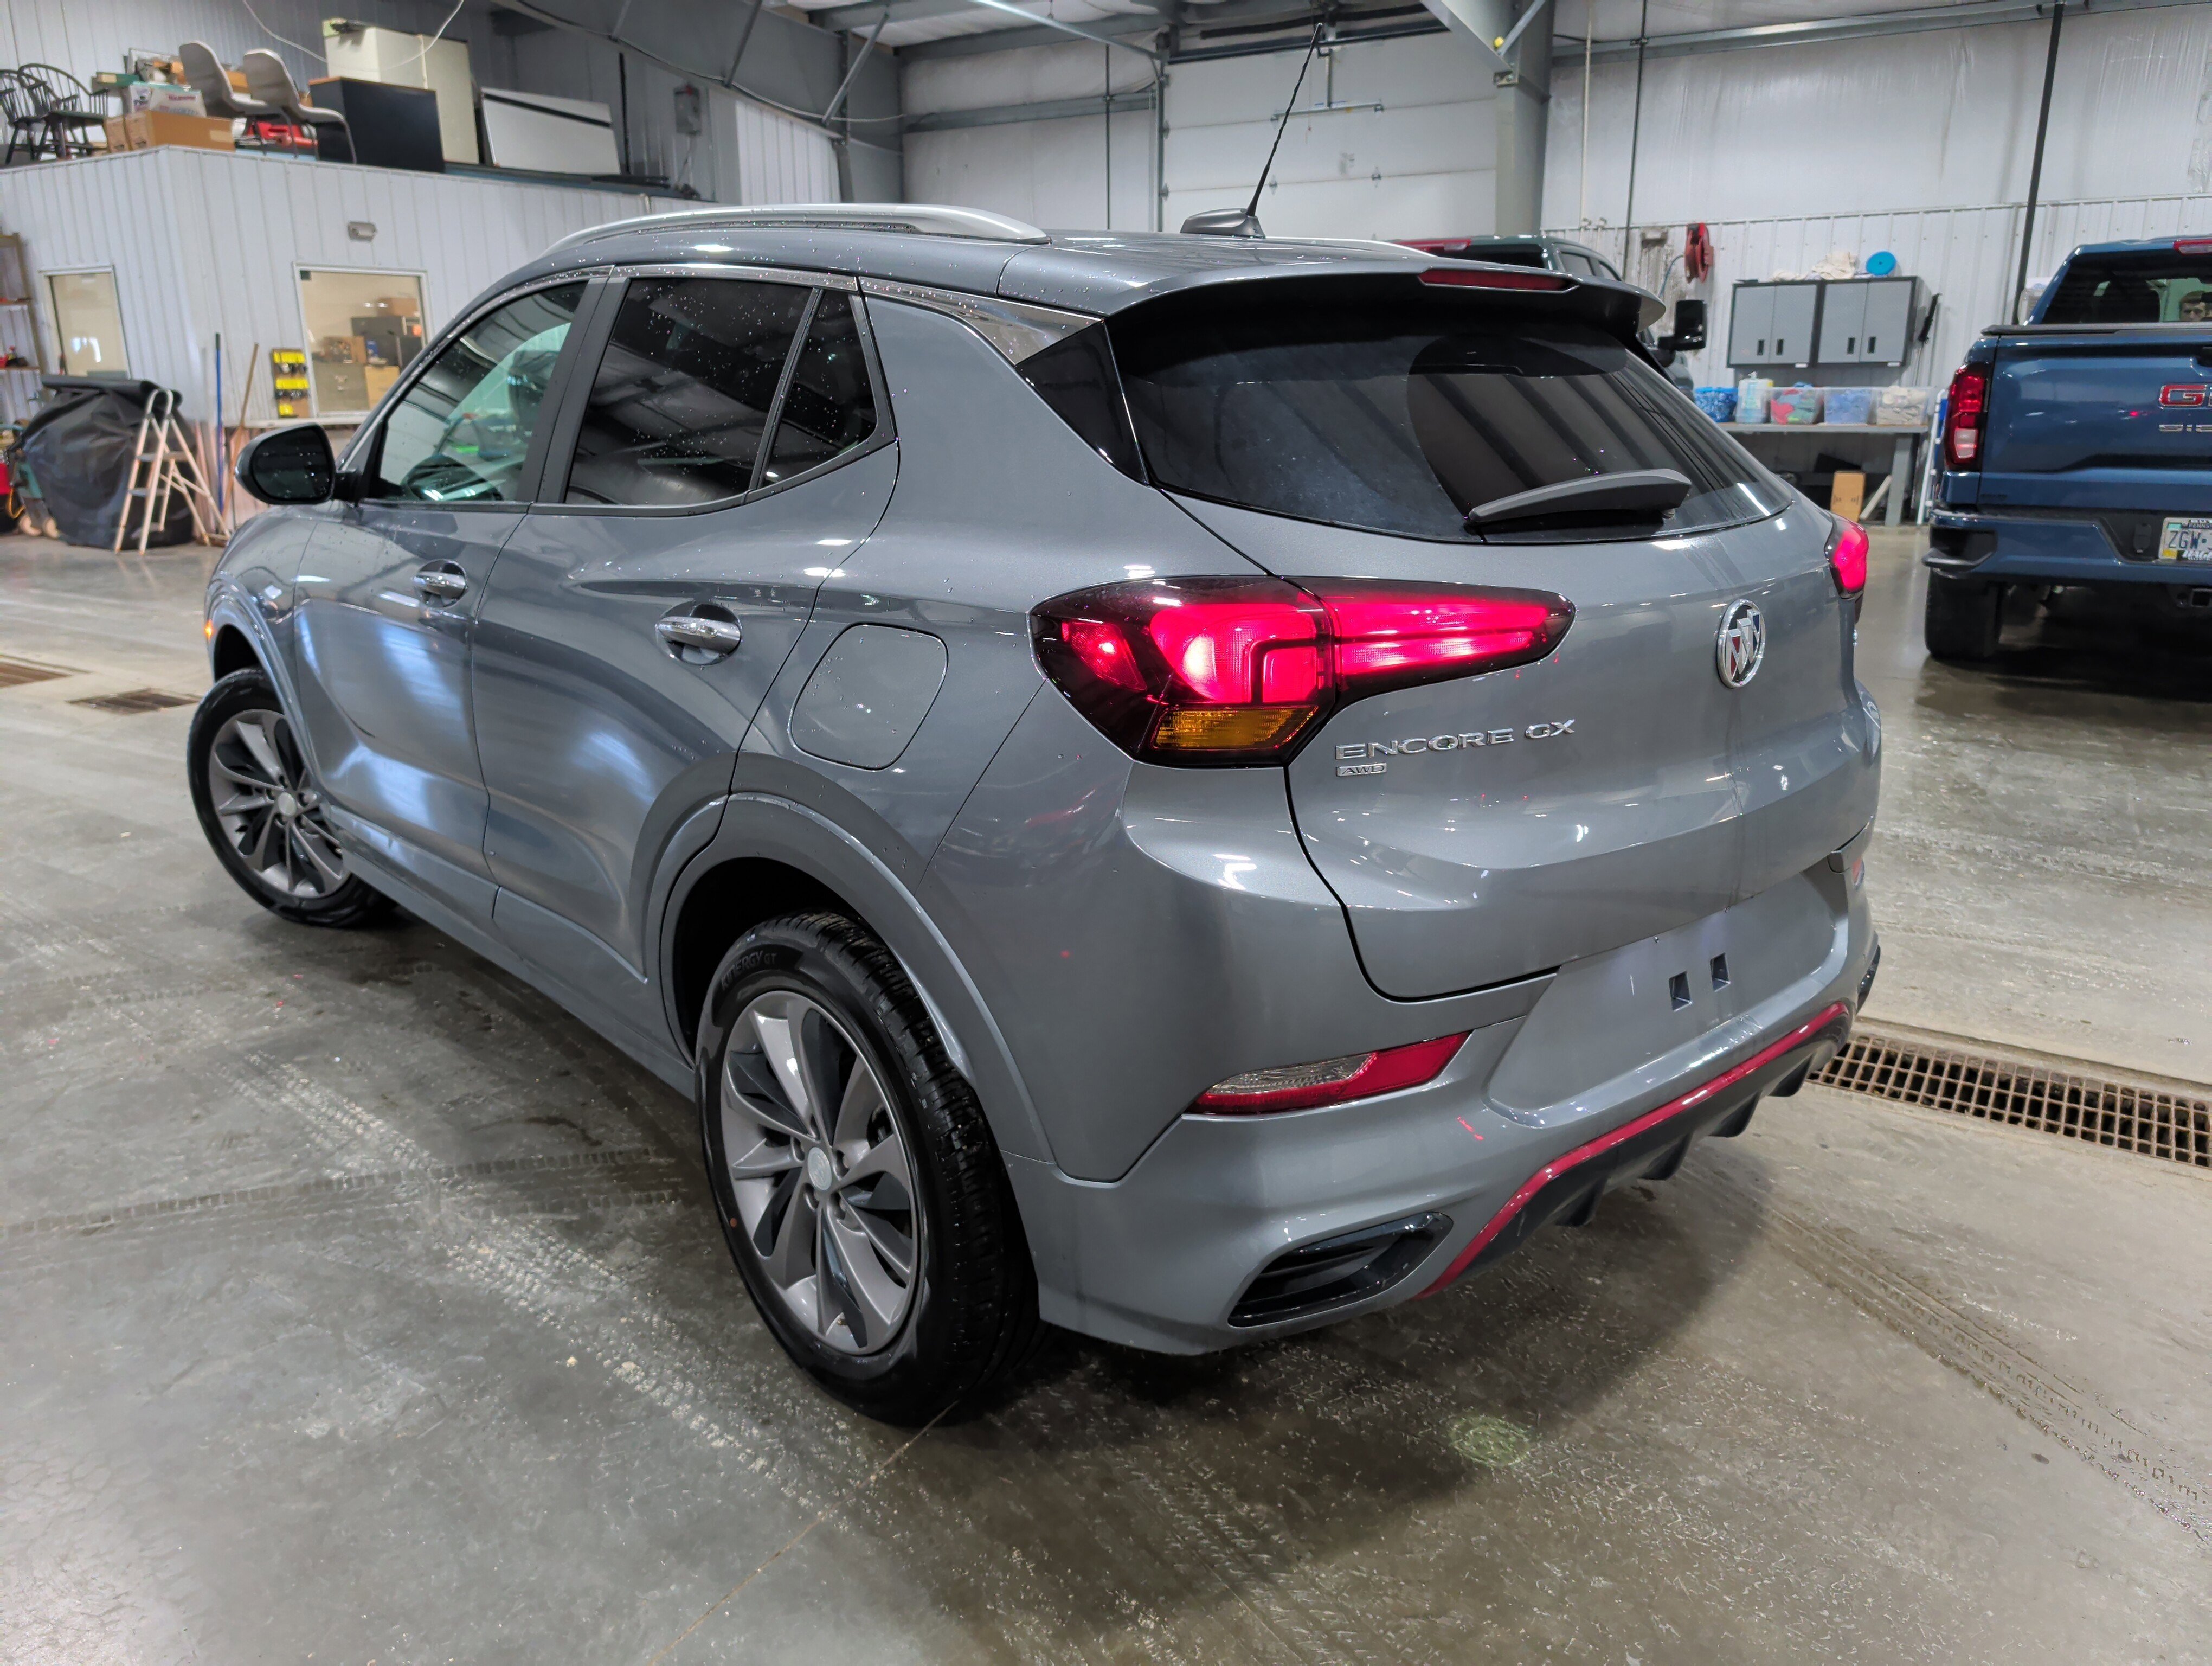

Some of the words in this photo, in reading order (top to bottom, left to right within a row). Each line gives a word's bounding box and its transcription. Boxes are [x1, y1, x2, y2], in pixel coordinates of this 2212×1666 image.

[2159, 384, 2212, 407] G
[1335, 728, 1514, 760] ENCORE
[1524, 719, 1576, 740] GX
[1341, 765, 1385, 775] AWD
[763, 953, 777, 965] GT
